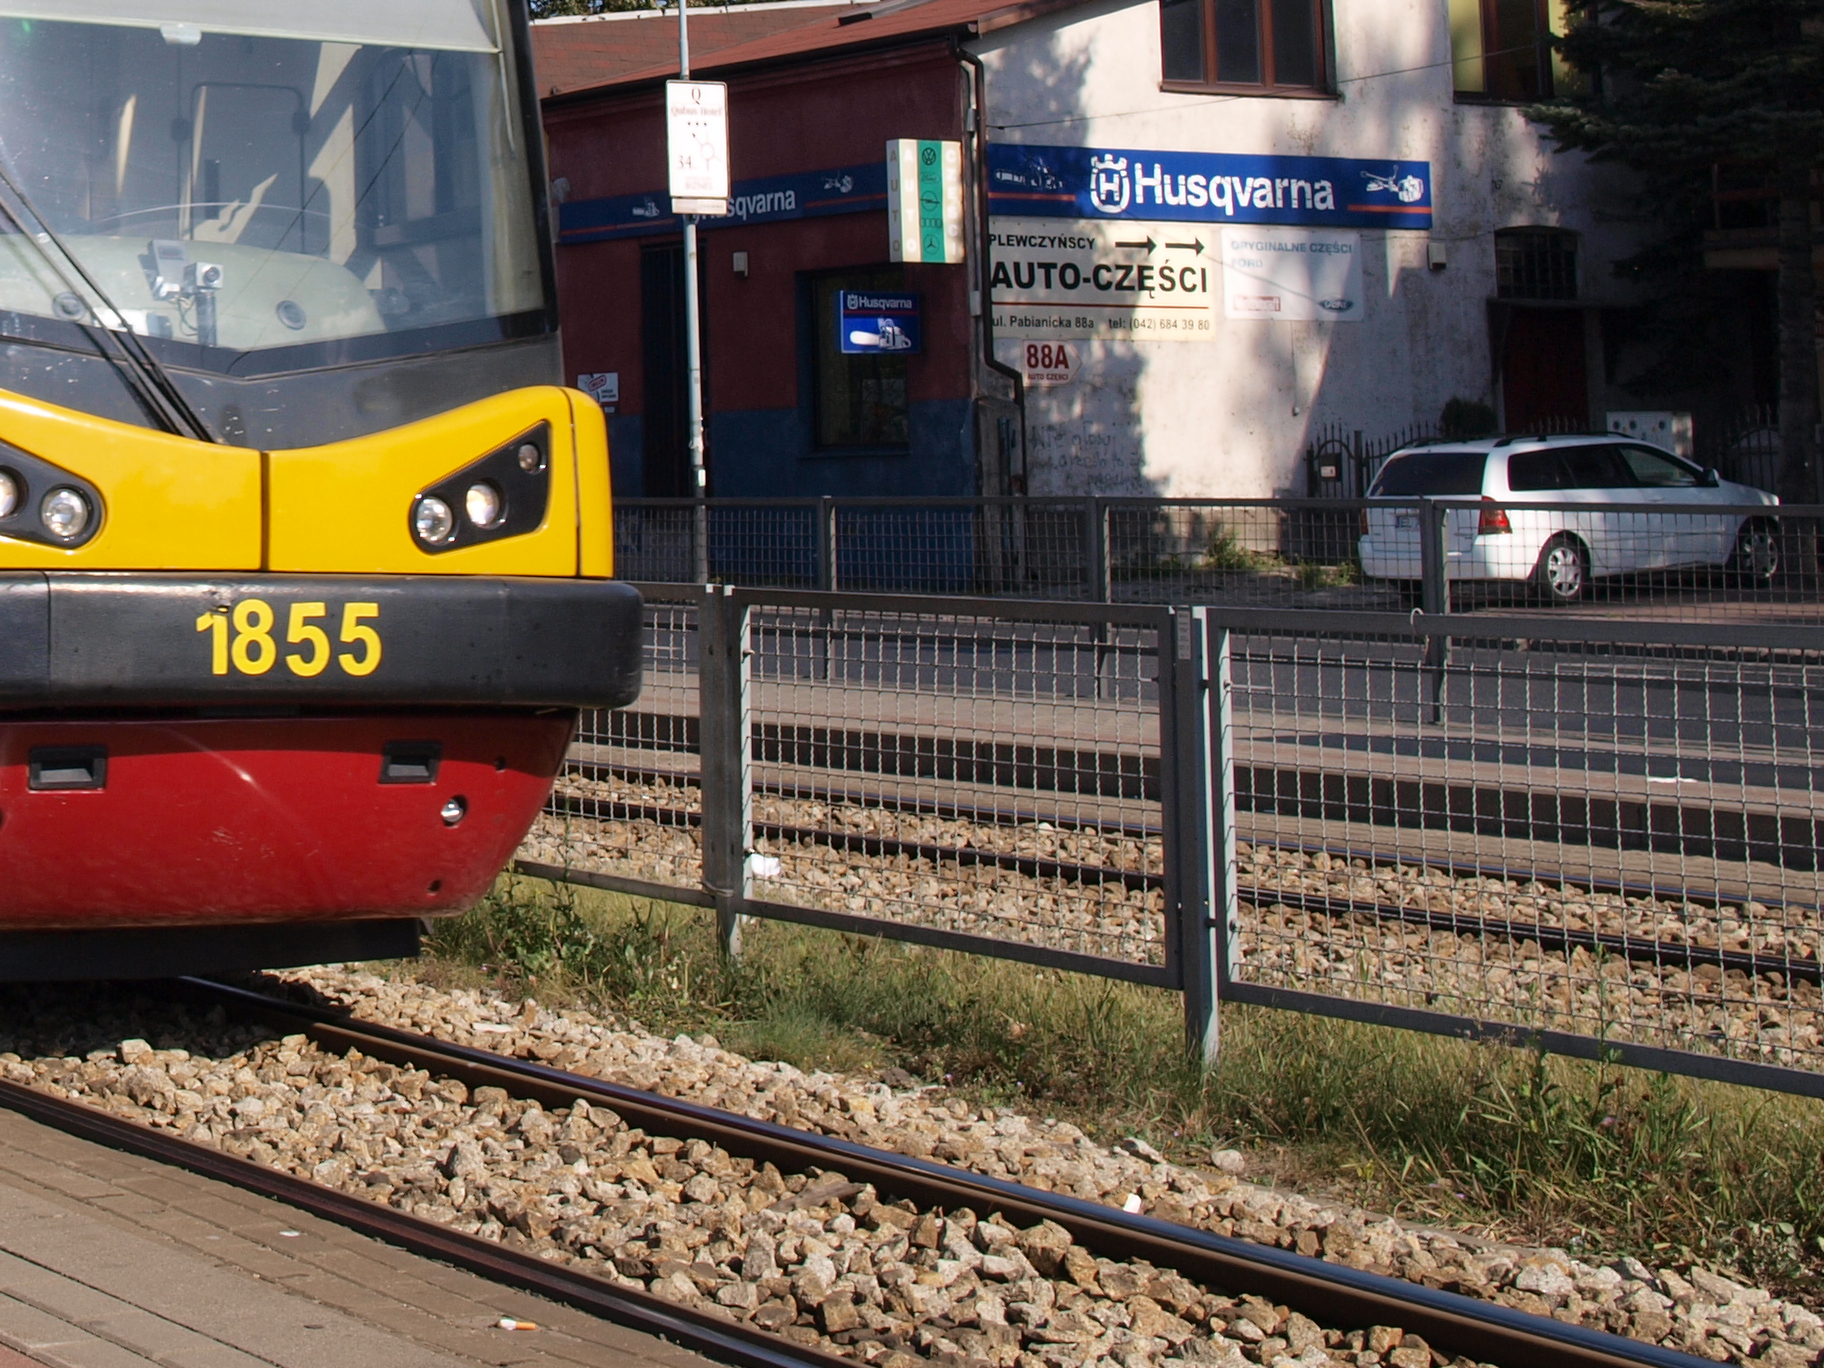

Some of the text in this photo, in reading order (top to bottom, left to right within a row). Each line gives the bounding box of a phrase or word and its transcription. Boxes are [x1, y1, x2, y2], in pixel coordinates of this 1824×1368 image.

[700, 189, 796, 220] sqvarna
[1133, 162, 1336, 217] Husqvarna
[991, 259, 1207, 299] AUTO-CZĘŚCI
[859, 295, 913, 311] Husqvarna
[1009, 316, 1072, 329] Pabianicka
[1075, 316, 1094, 329] 88a
[1108, 318, 1126, 329] tel:
[1129, 318, 1157, 331] (042)
[1159, 318, 1178, 330] 684
[1181, 319, 1194, 330] 39
[1197, 320, 1210, 331] 80
[1026, 343, 1070, 370] 88A
[196, 598, 383, 678] 1855
